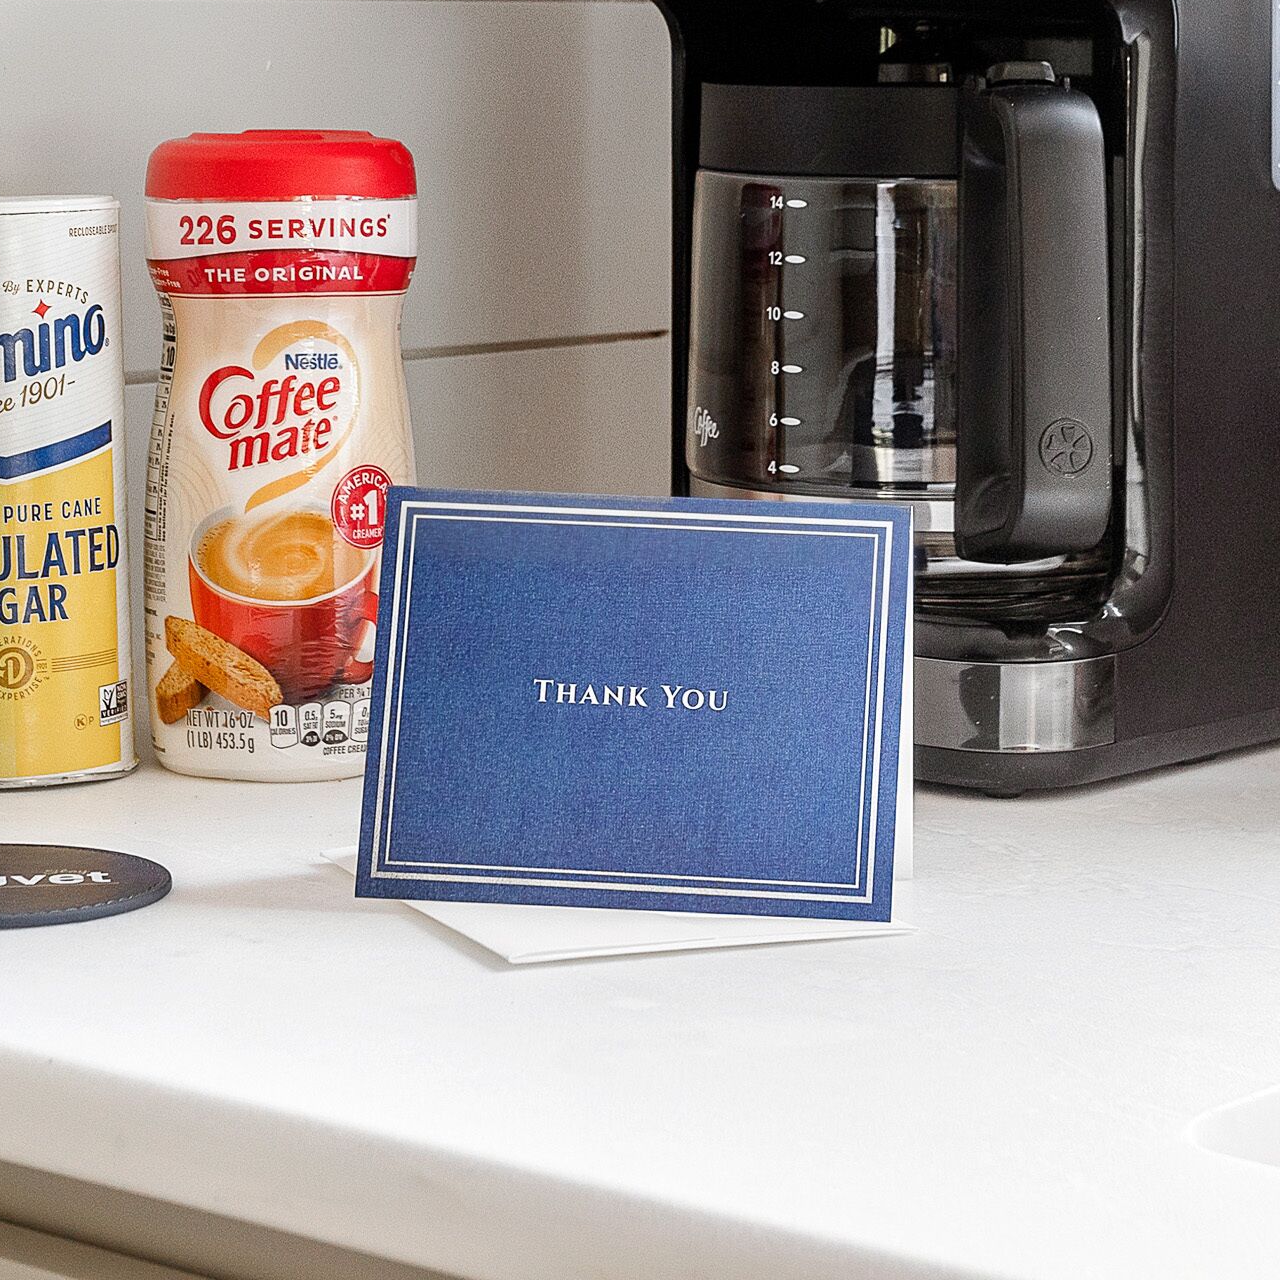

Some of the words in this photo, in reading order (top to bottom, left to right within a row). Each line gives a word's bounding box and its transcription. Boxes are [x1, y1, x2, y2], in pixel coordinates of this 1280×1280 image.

[770, 196, 784, 209] 14
[179, 215, 237, 245] 226
[769, 252, 782, 265] 12
[204, 268, 246, 283] THE
[254, 267, 363, 283] ORIGINAL
[2, 280, 20, 296] By
[26, 279, 89, 304] EXPERTS
[767, 307, 781, 320] 10
[771, 361, 780, 374] 8
[199, 365, 340, 440] Coffee
[769, 414, 778, 426] 6
[228, 418, 331, 471] mate
[768, 462, 777, 474] 4
[4, 502, 53, 524] PURE
[62, 497, 101, 518] CANE
[350, 489, 378, 526] #1
[187, 709, 202, 727] NET
[205, 711, 220, 728] WT
[222, 712, 236, 729] 16
[239, 712, 254, 729] OZ
[275, 709, 288, 727] 10
[187, 730, 195, 748] (1
[198, 731, 213, 750] LB)
[323, 745, 346, 756] COFFEE
